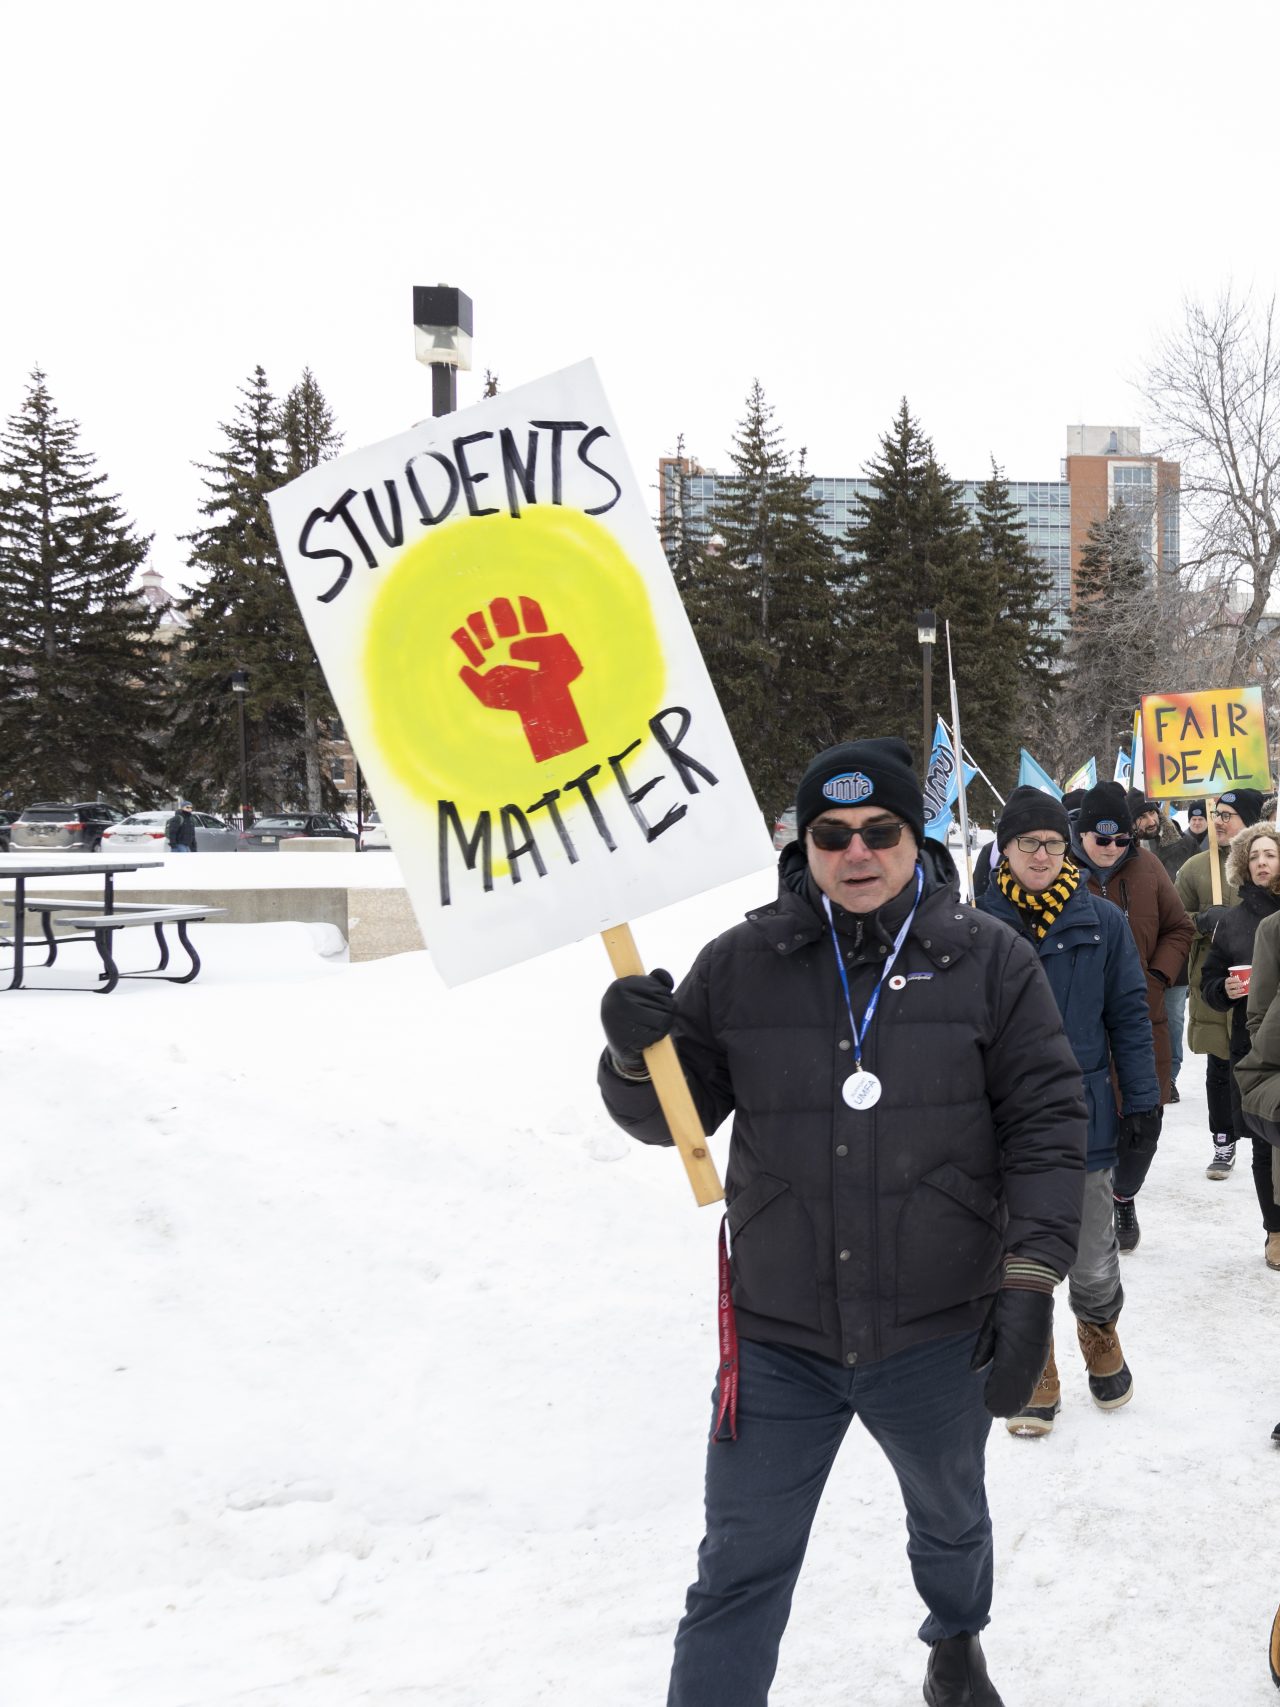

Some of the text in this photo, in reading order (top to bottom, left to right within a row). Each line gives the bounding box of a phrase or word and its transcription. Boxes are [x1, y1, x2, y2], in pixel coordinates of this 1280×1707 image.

[299, 420, 622, 603] STUDENTS
[1155, 702, 1249, 743] FAIR
[823, 772, 873, 800] umfa
[1159, 748, 1254, 786] DEAL
[438, 706, 719, 906] MATTER
